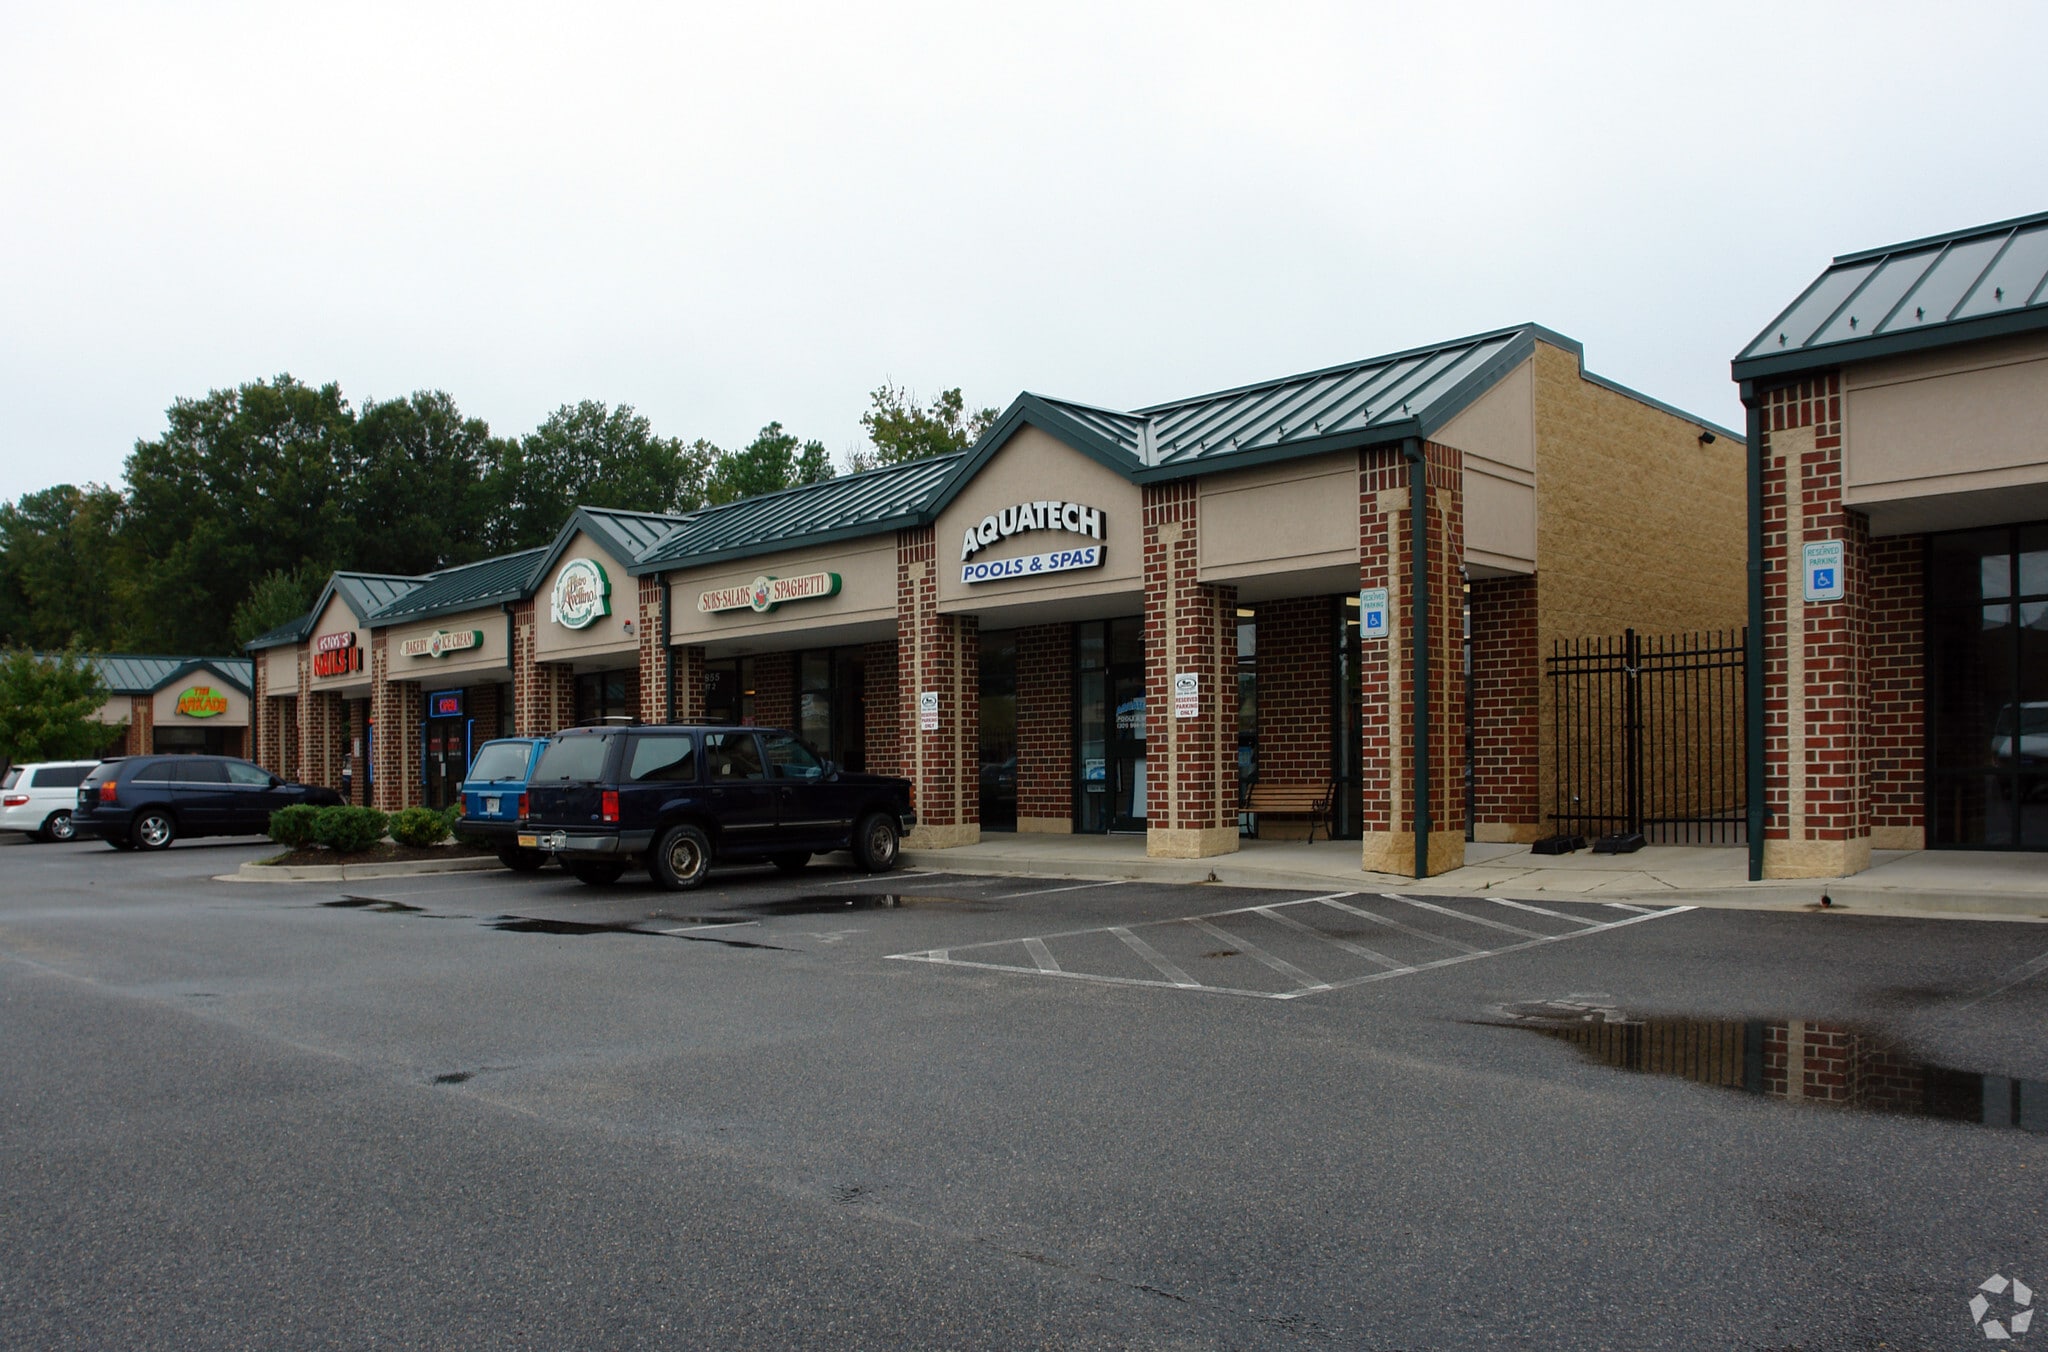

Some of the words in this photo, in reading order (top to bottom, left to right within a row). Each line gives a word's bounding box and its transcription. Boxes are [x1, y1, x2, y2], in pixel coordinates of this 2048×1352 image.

[960, 500, 1104, 562] AQUATECH
[1808, 547, 1839, 556] RESERVED
[1810, 557, 1837, 566] PARKING
[963, 559, 1023, 581] POOLS
[1029, 556, 1043, 572] &
[1048, 548, 1095, 569] SPAS
[774, 575, 824, 599] SPAGHETTI
[319, 632, 350, 650] KIM'S
[313, 648, 349, 677] NAILS
